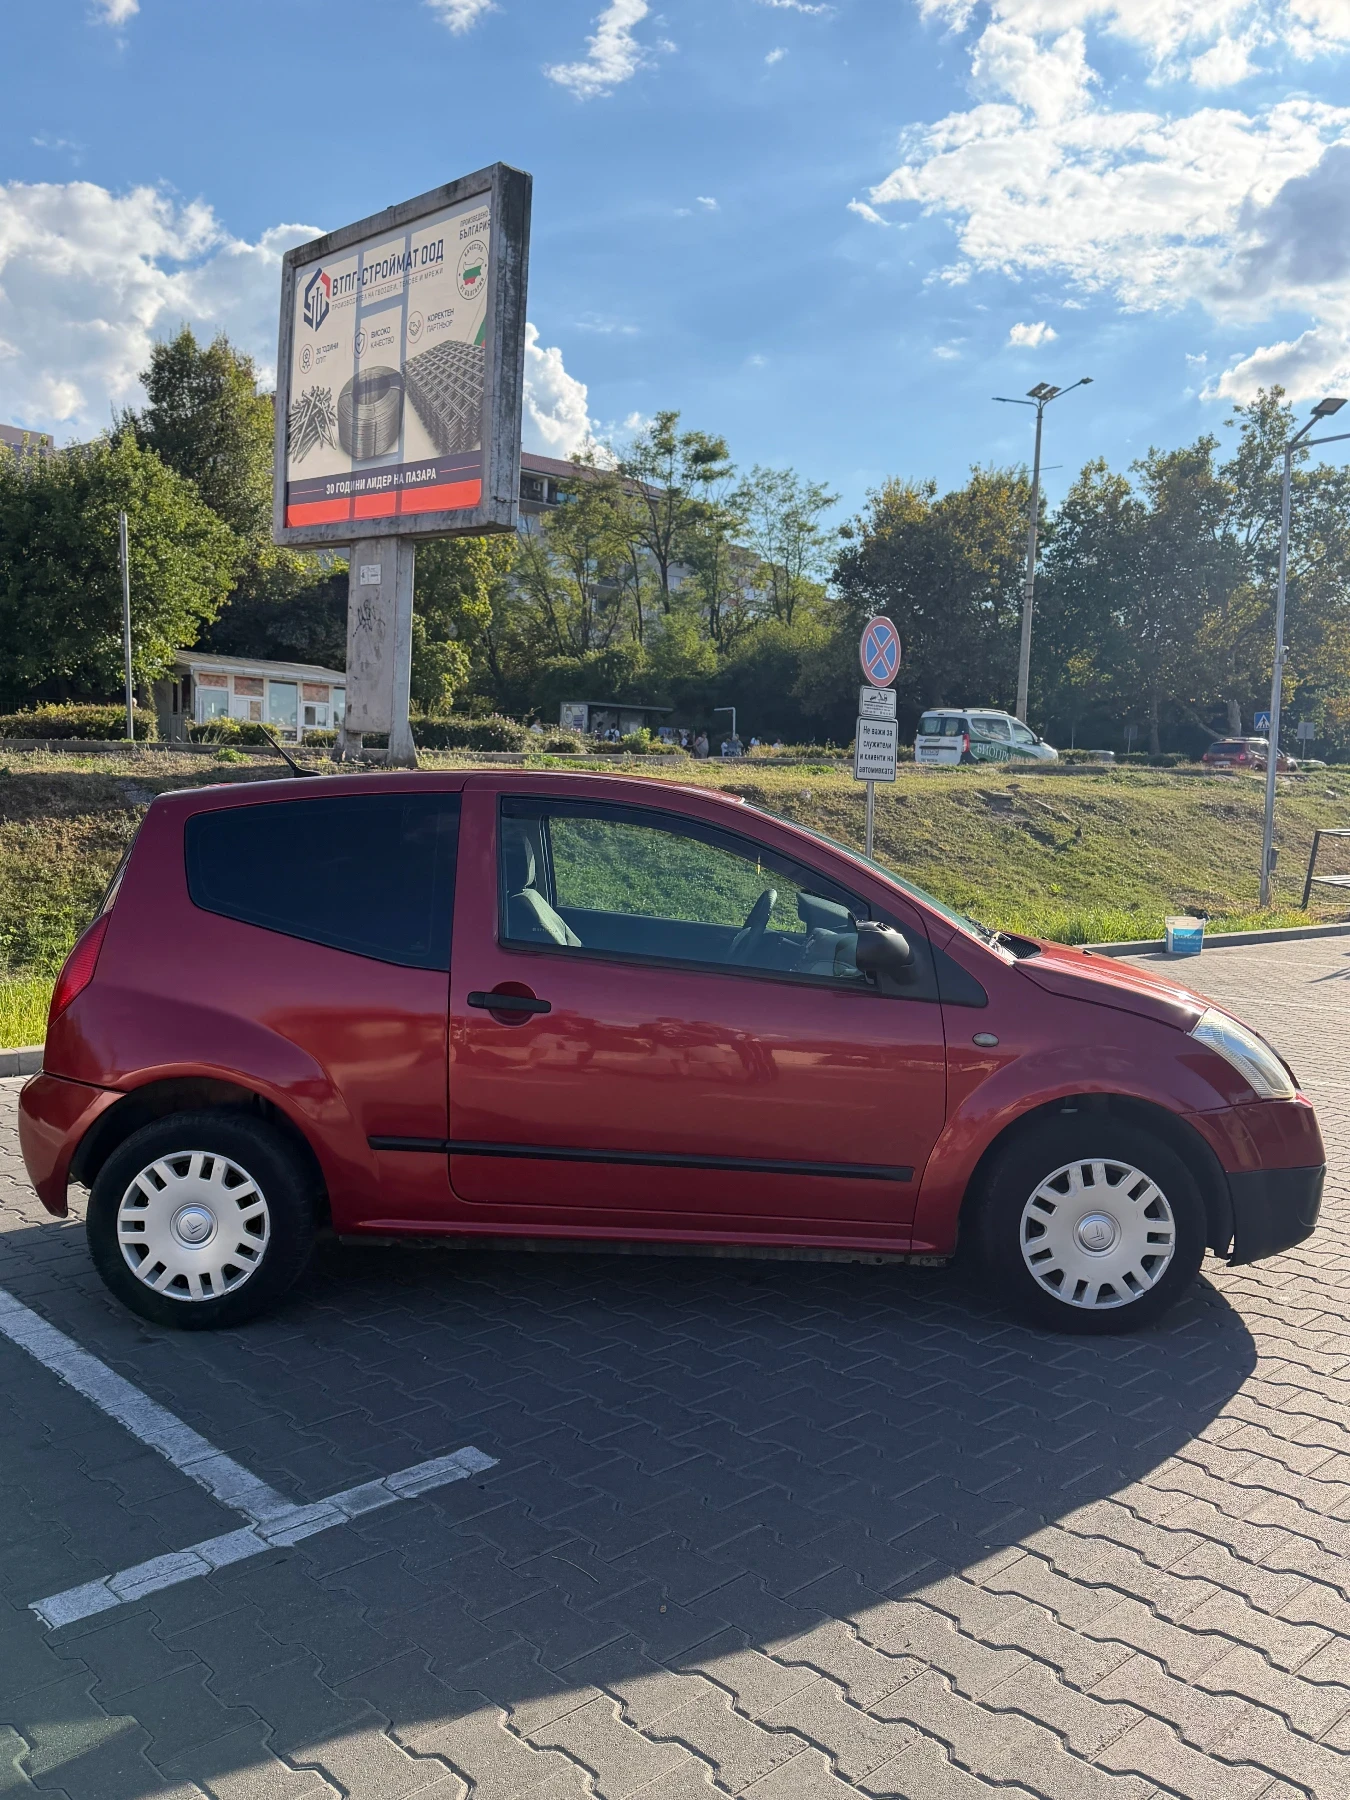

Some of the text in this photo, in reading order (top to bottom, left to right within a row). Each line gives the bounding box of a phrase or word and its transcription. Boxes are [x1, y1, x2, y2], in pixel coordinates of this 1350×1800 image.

[460, 210, 488, 227] ПРОИЗВЕДЕНО
[464, 243, 484, 257] КАЧЕСТВО
[332, 238, 444, 297] ВТПГ-СТРОЙМАТ ООД
[424, 267, 443, 280] МРЕЖИ
[427, 308, 455, 323] КОРЕКТЕН
[370, 326, 391, 339] ВИСОКО
[426, 319, 453, 333] ПАРТНЬОР
[321, 342, 339, 353] ГОДИНИ
[370, 336, 395, 349] КАЧЕСТВО
[325, 467, 437, 495] 30 ГОДИНИ ЛИДЕР НА ПАЗАРА
[863, 725, 893, 737] Не важи за
[863, 740, 892, 750] служители
[864, 754, 886, 762] клиенти
[858, 766, 894, 775] автомивката
